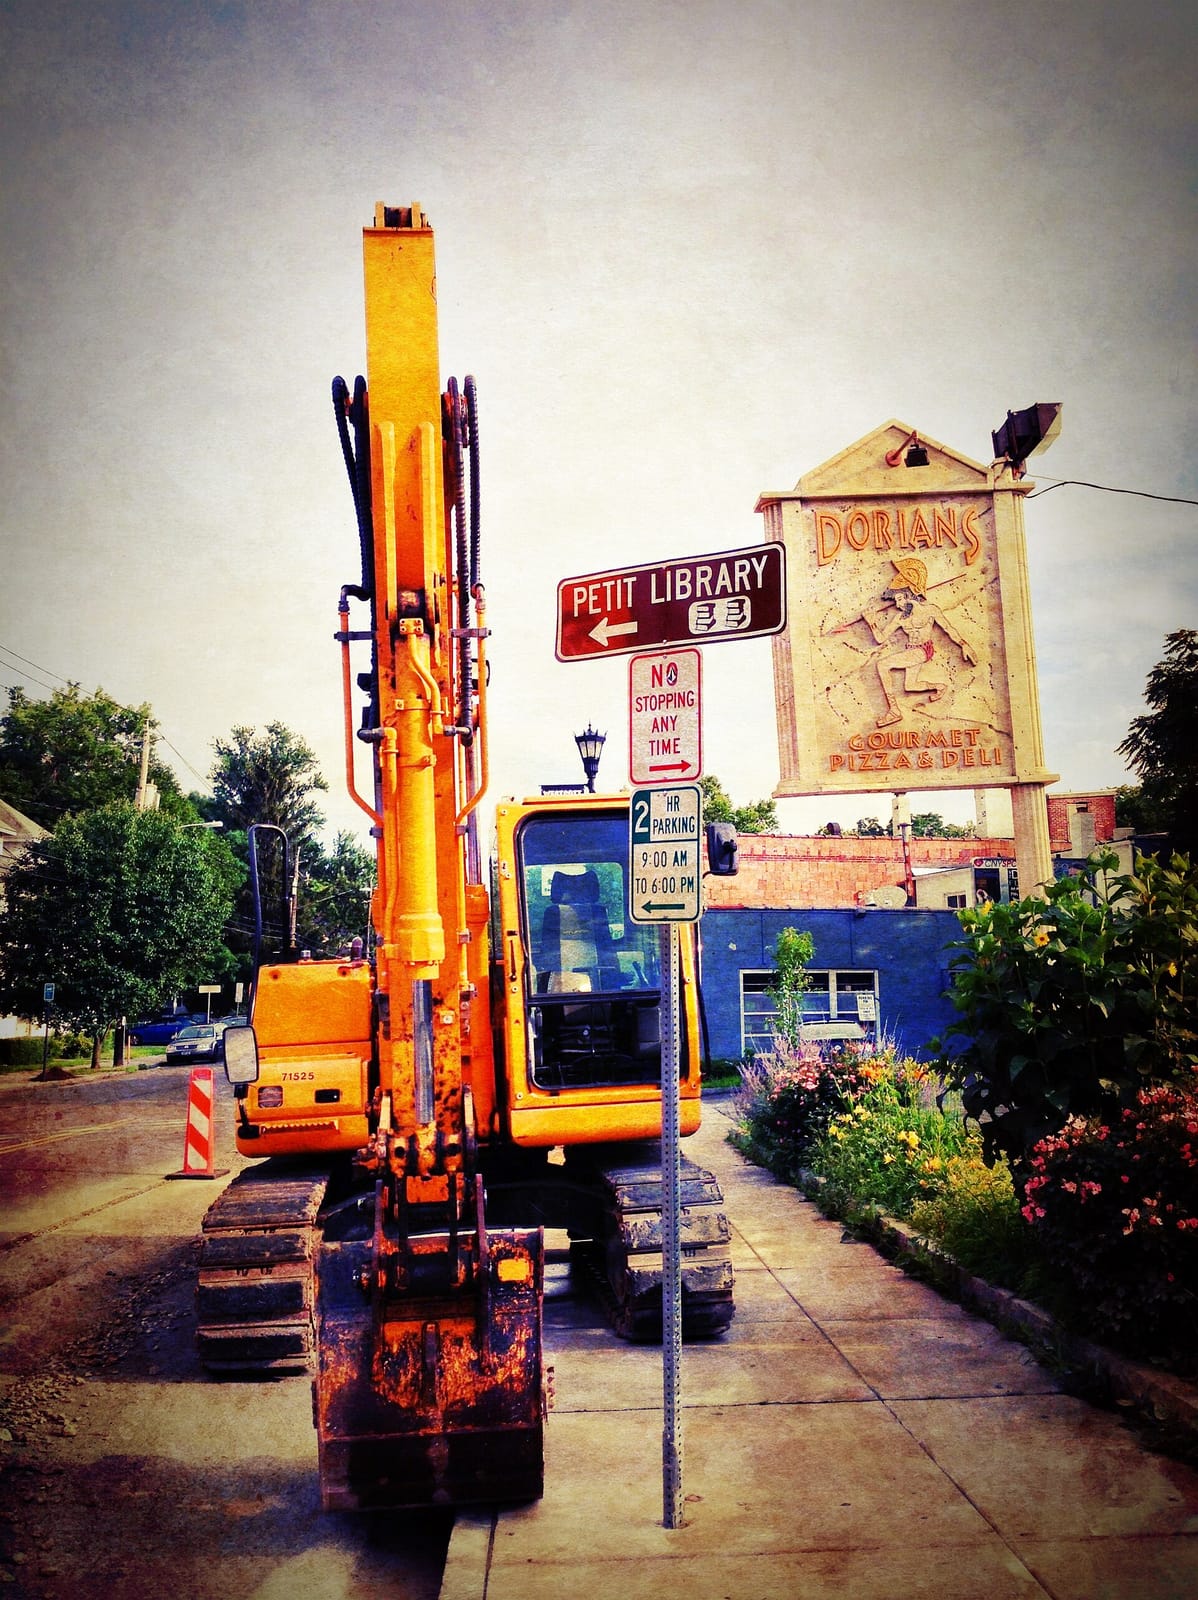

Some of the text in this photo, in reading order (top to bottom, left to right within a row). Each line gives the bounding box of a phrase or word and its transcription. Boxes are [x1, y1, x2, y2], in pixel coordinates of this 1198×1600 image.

[814, 507, 982, 567] DORIANS
[573, 554, 768, 618] PETIT LIBRARY
[651, 661, 679, 689] NO
[635, 690, 695, 712] STOPPING
[651, 715, 678, 733] ANY
[648, 737, 681, 756] TIME
[849, 728, 981, 751] GOURMET
[830, 748, 1003, 773] PIZZA & DELI
[666, 795, 680, 812] HR
[634, 800, 649, 833] 2
[652, 816, 695, 836] PARKING
[642, 850, 688, 868] 9:00 AM
[635, 876, 695, 894] TO 6:00 PM
[281, 1072, 315, 1081] 71525
